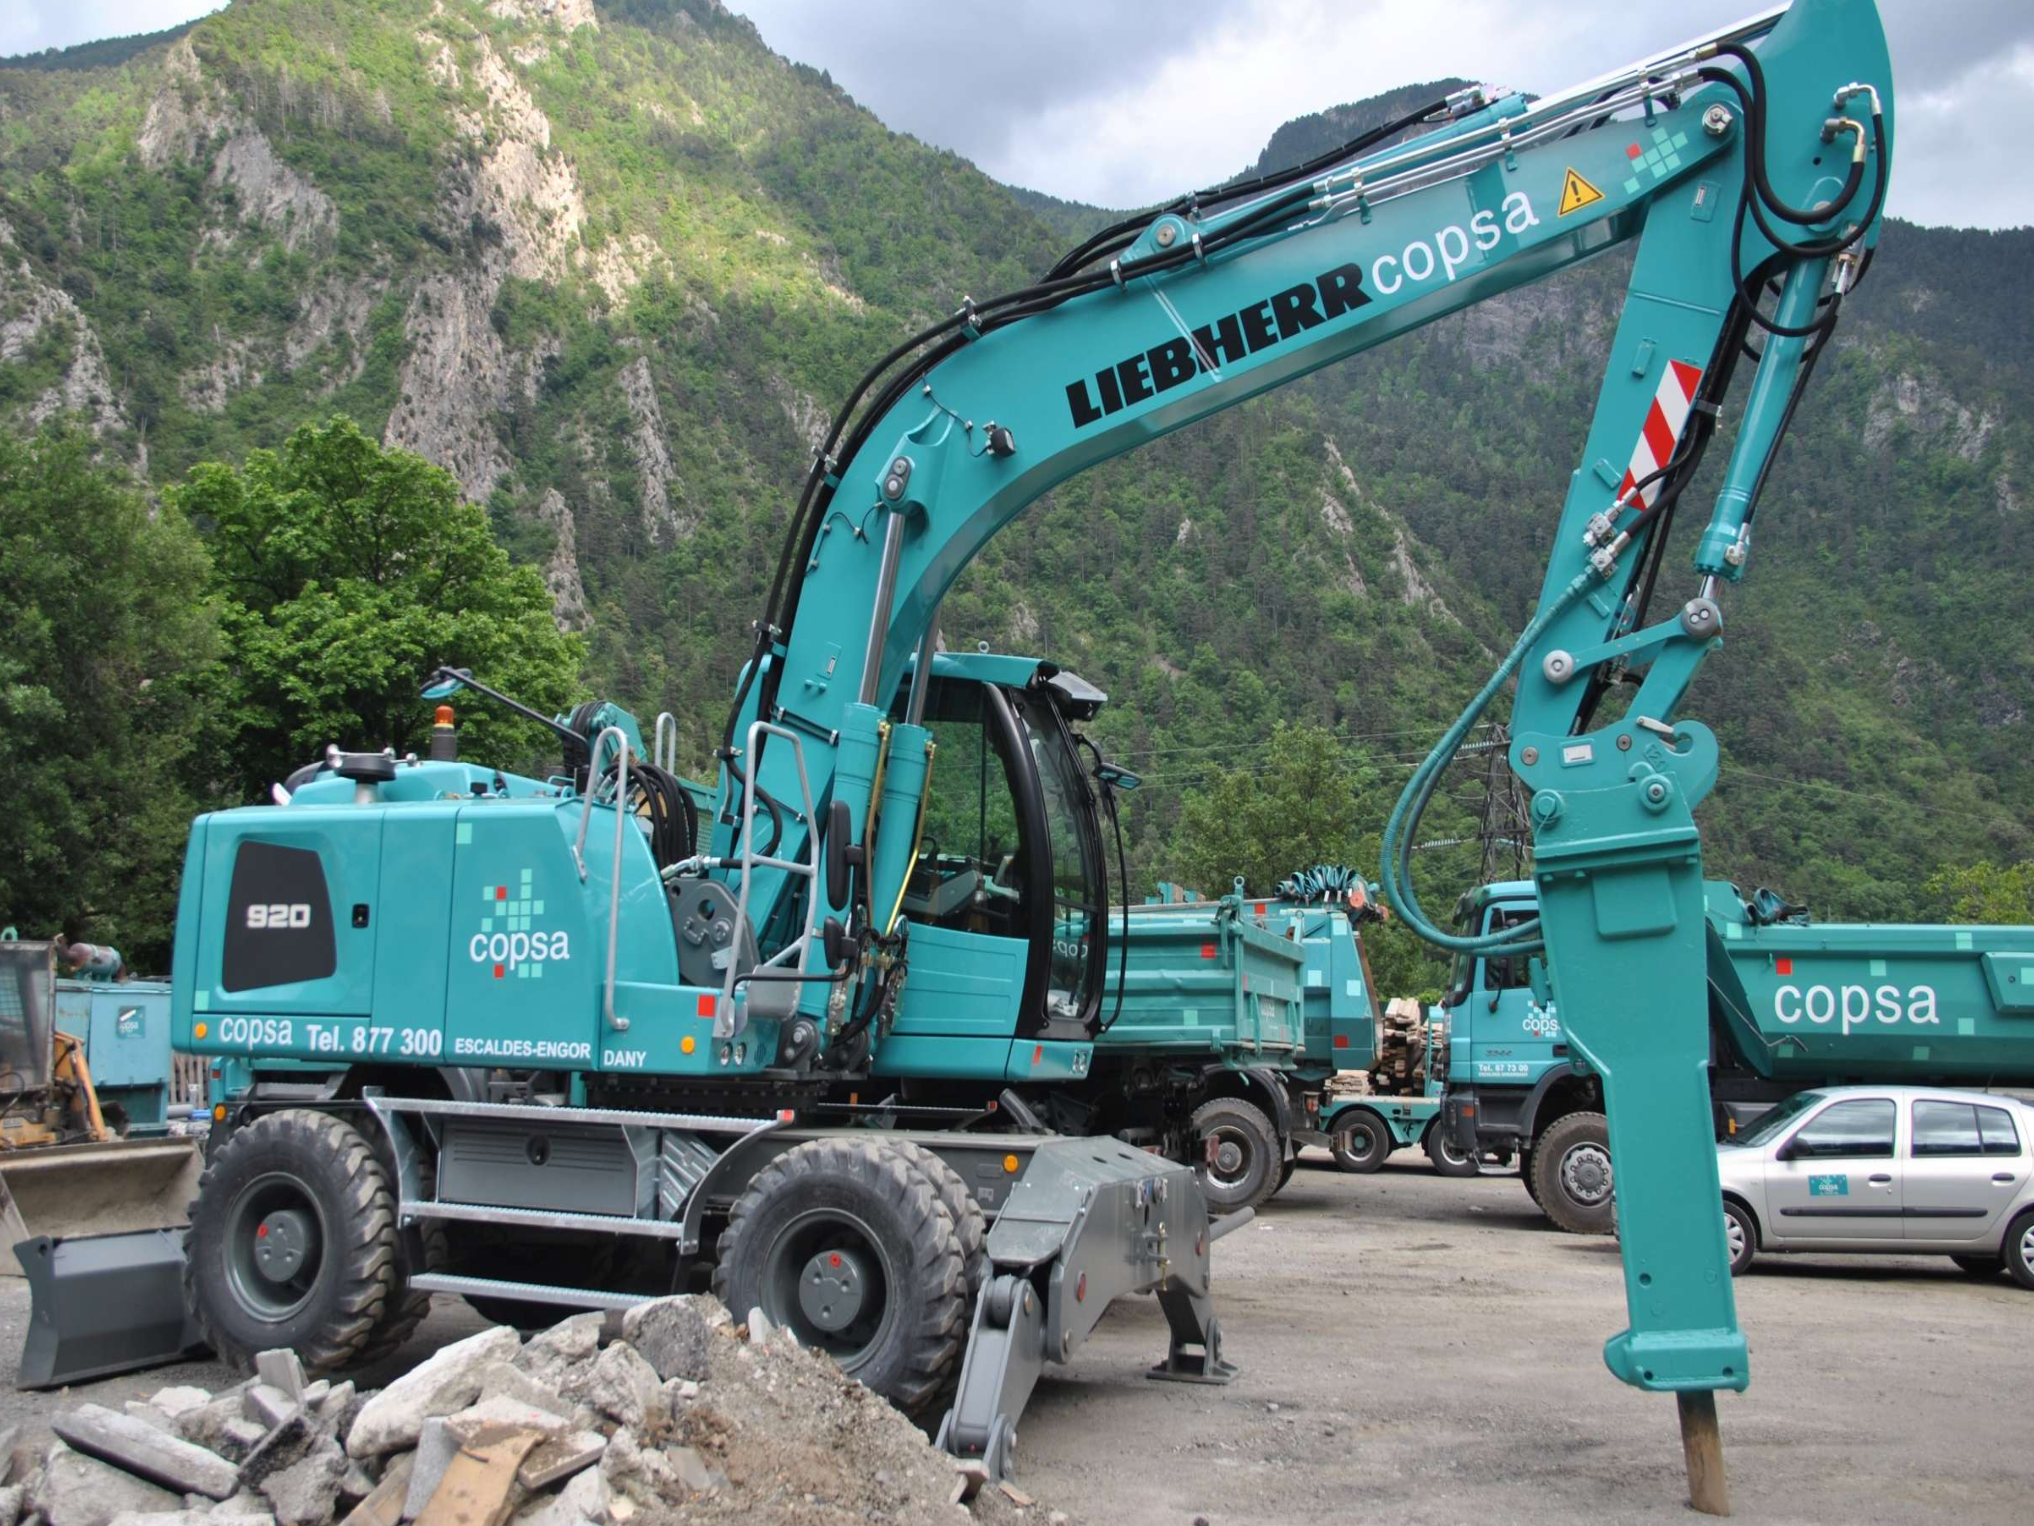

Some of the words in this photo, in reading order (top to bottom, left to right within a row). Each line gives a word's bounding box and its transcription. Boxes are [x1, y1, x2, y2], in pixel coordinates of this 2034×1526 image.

[1371, 191, 1541, 295] copsa
[1065, 262, 1373, 429] LIEBHERR
[246, 904, 311, 929] 920
[469, 930, 570, 971] copsa
[1522, 1019, 1561, 1035] cops
[1774, 983, 1940, 1035] copsa
[219, 1017, 293, 1051] copsa
[306, 1024, 345, 1051] Tel.
[352, 1026, 394, 1053] 877
[400, 1028, 442, 1056] 300
[455, 1037, 591, 1059] ESCALDES-ENGOR
[603, 1050, 647, 1067] DANY
